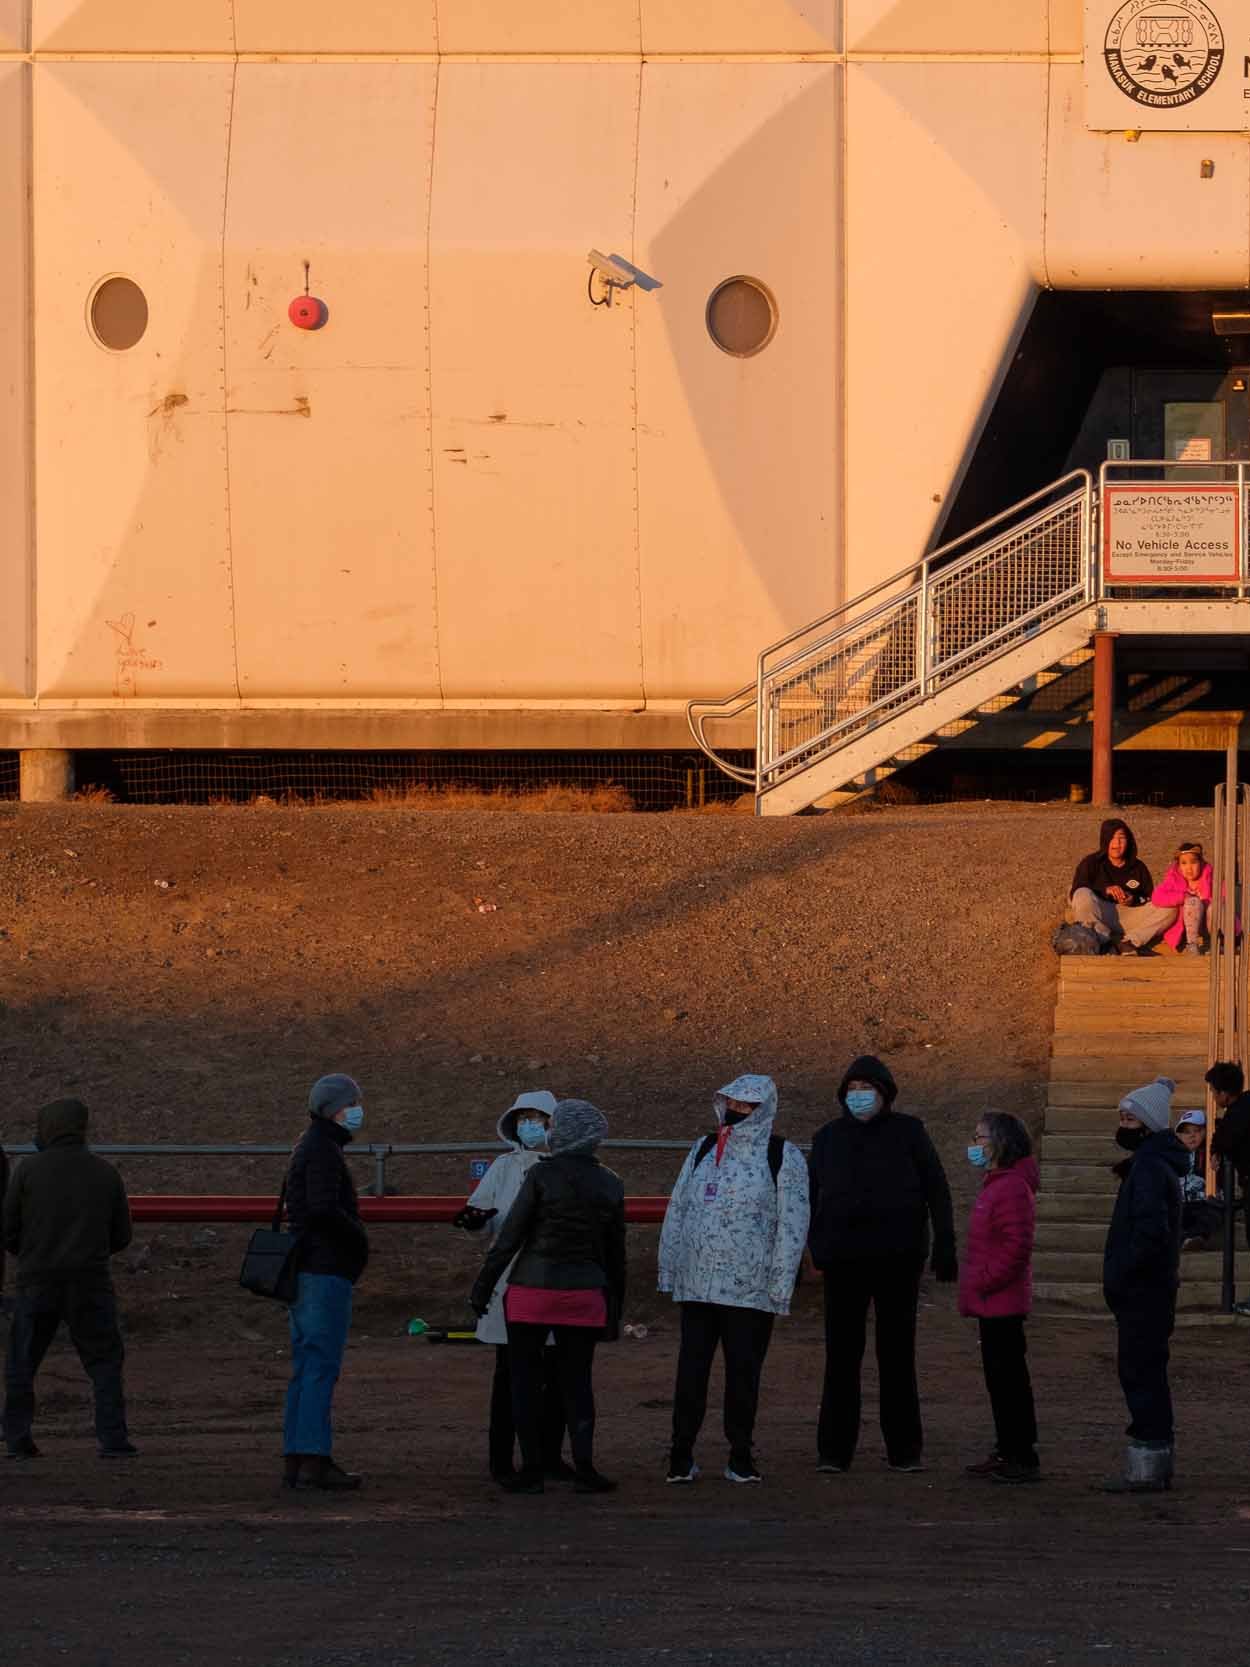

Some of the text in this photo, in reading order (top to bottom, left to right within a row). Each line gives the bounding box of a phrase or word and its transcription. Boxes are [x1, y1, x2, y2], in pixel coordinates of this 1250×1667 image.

[1107, 53, 1221, 105] NAKASUK ELEMENTARY SCHOOL
[1116, 540, 1229, 550] No Vehicle Access
[475, 1163, 484, 1176] 9
